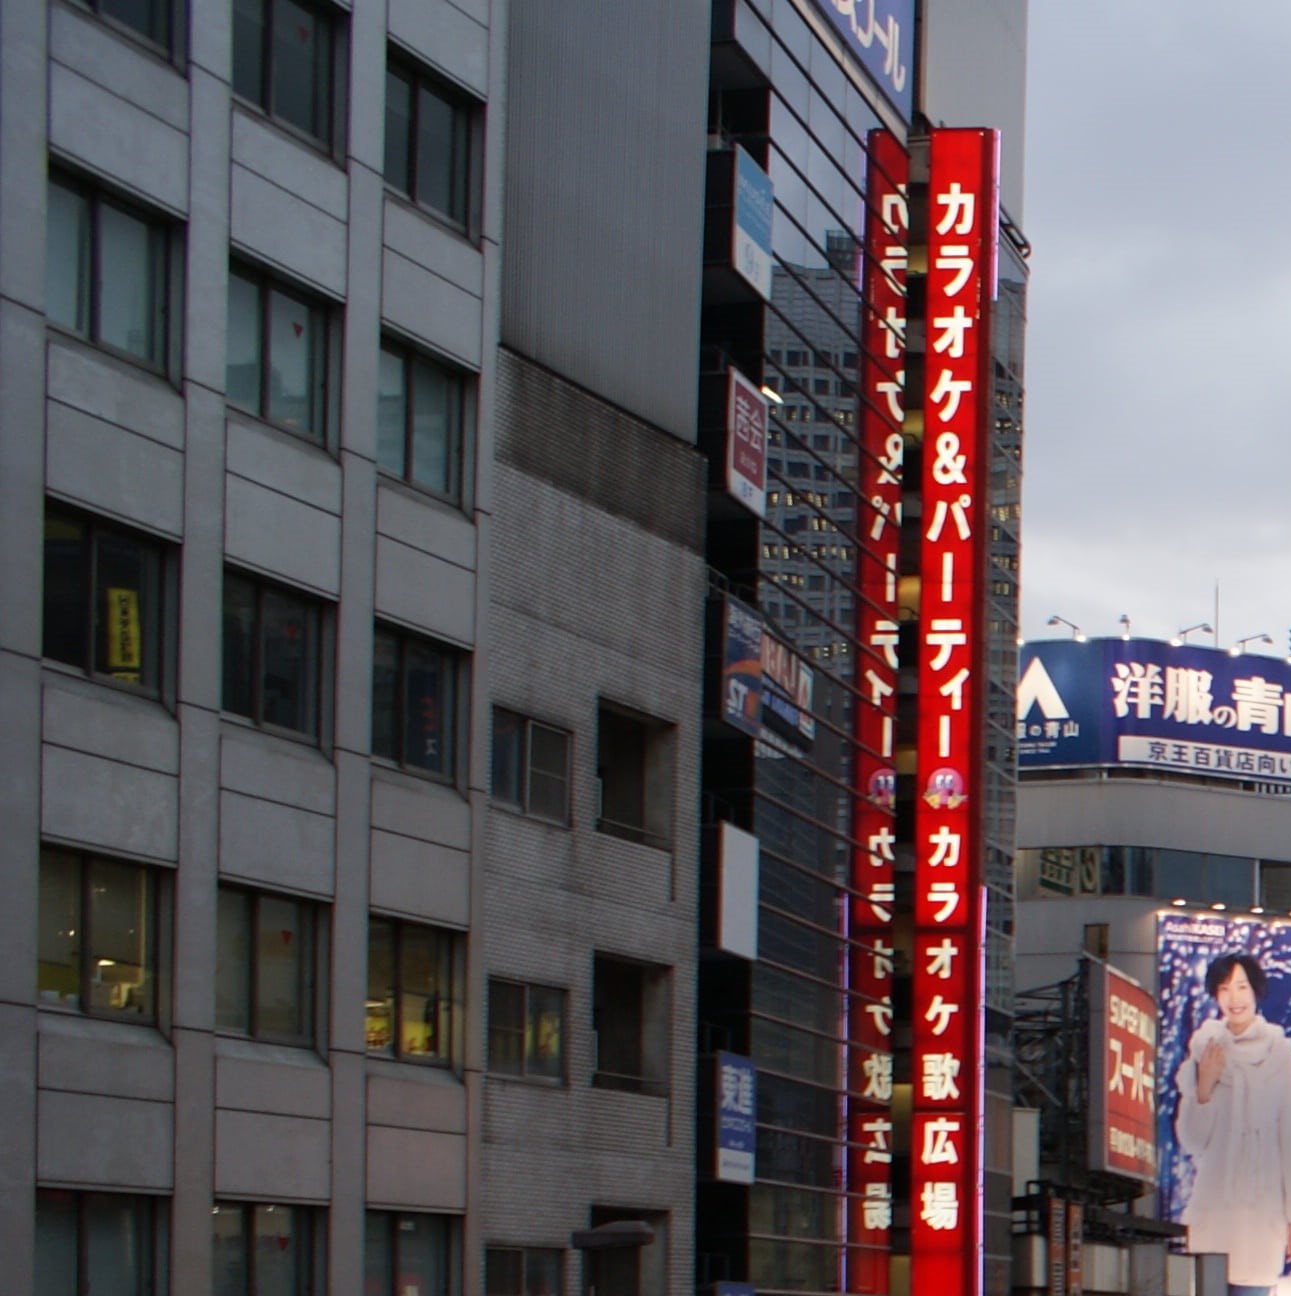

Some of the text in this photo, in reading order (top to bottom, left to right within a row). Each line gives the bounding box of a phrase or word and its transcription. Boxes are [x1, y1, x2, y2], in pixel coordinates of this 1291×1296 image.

[925, 183, 975, 758] カラオケ&パーティー
[920, 826, 961, 1232] カラオケ歌広場
